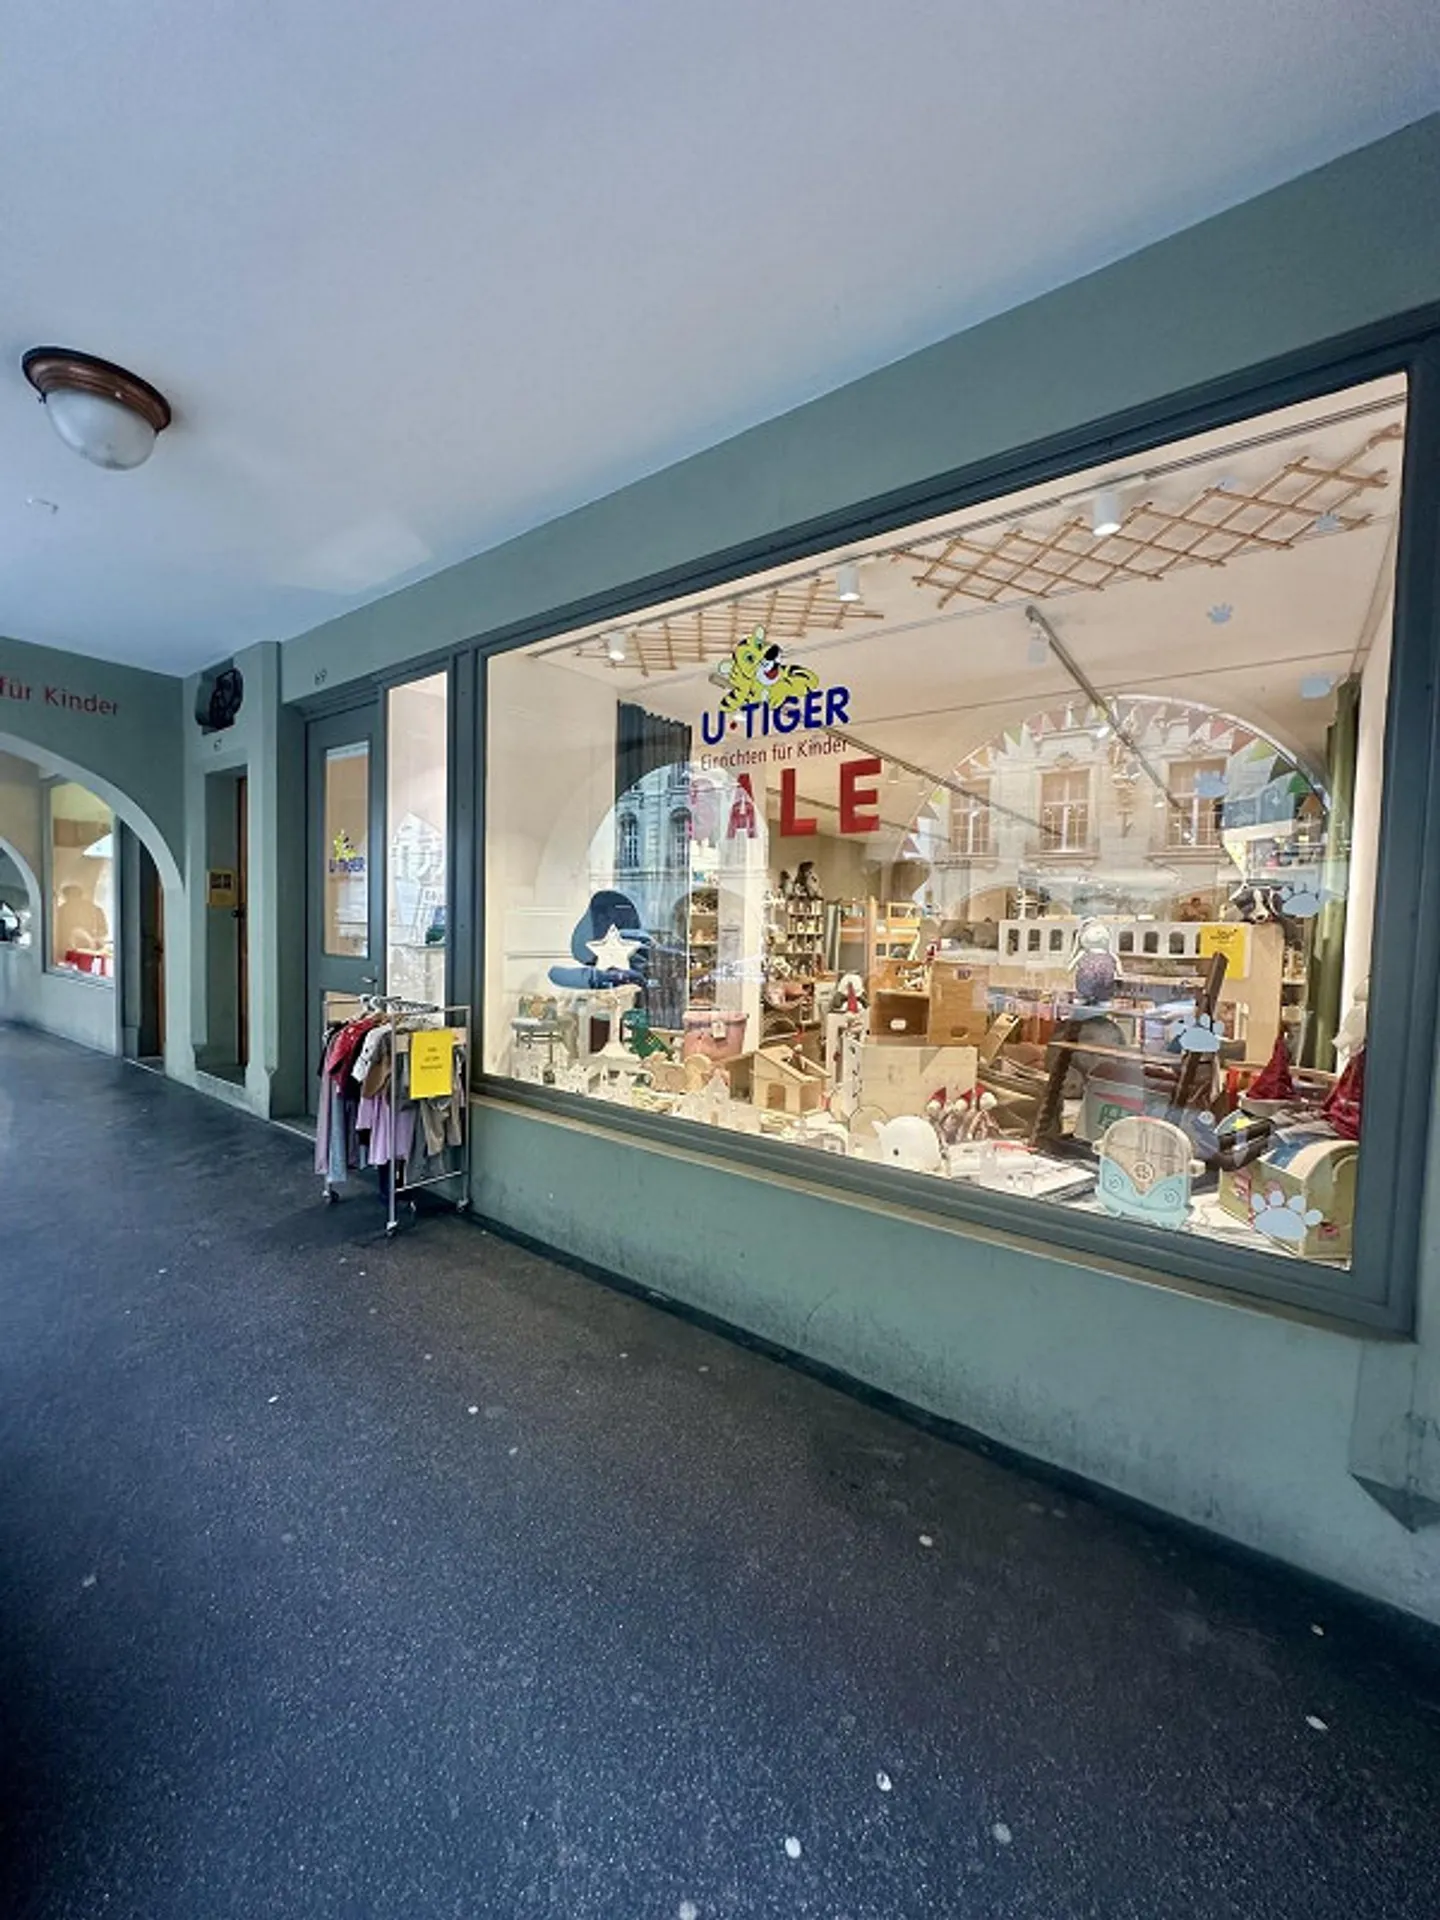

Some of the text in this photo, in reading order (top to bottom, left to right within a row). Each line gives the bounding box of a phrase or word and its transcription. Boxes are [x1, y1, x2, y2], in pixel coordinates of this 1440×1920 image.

[45, 687, 117, 715] Kinder
[772, 743, 794, 761] für
[797, 736, 849, 758] Kinder
[689, 758, 882, 838] ALE
